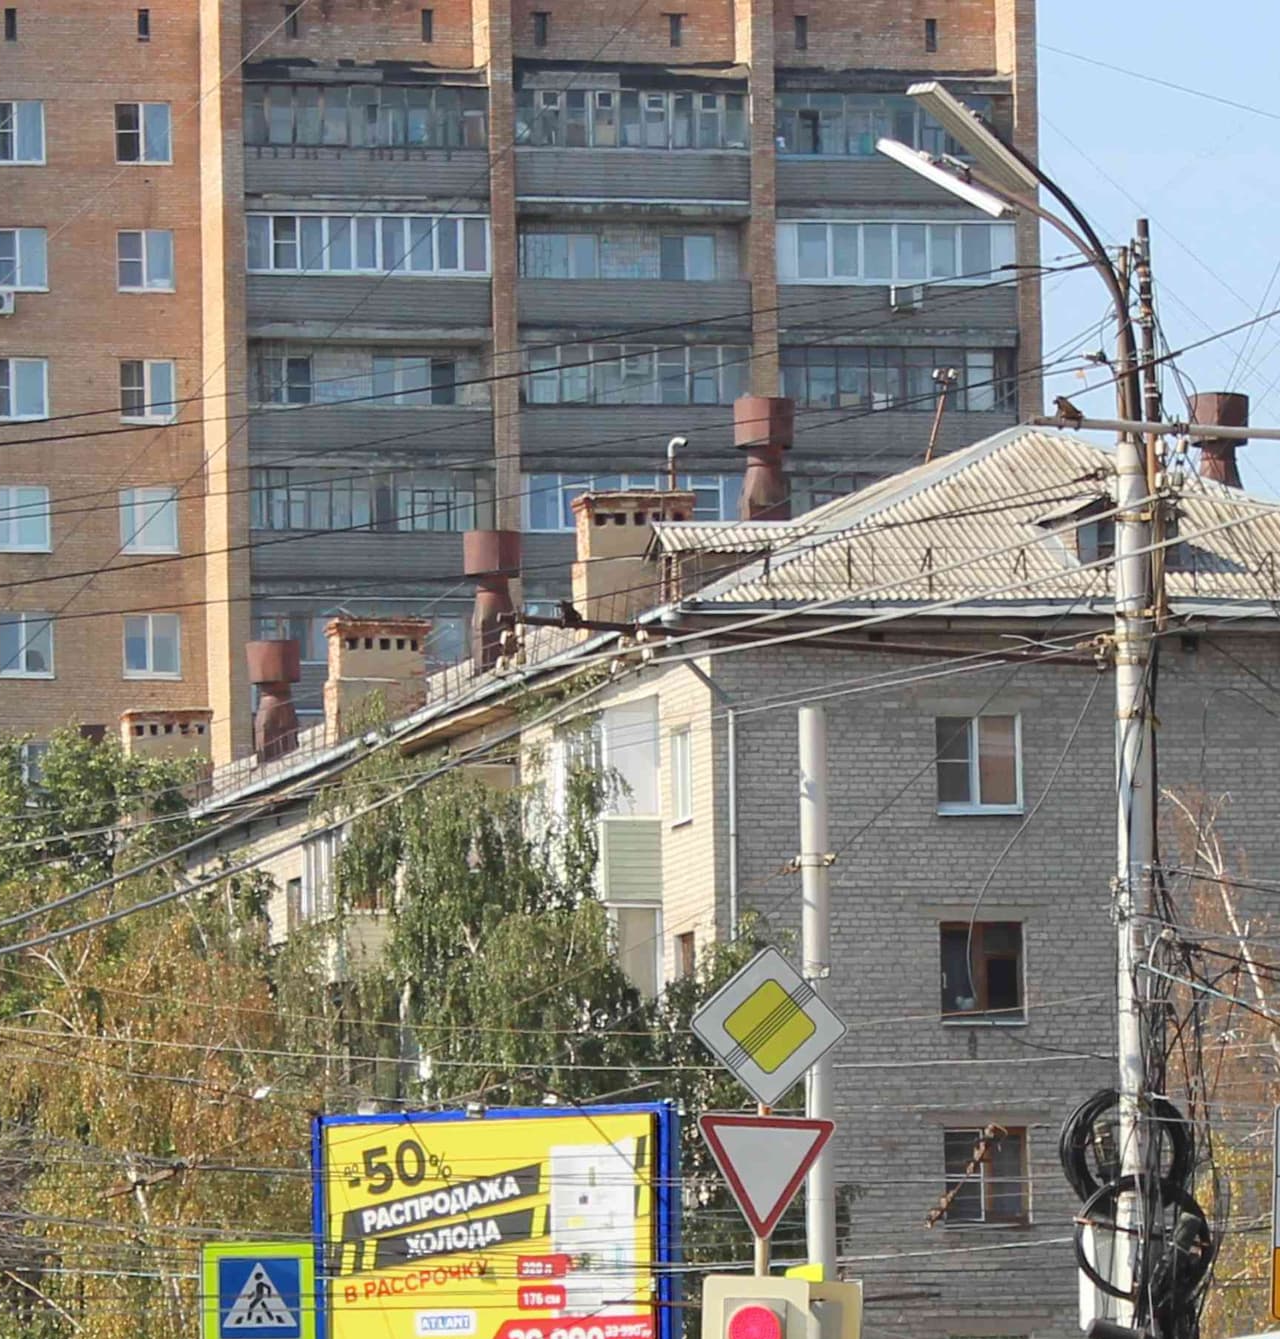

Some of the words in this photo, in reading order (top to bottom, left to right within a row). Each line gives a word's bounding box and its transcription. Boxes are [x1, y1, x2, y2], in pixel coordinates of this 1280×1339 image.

[348, 1139, 452, 1194] -50%
[362, 1176, 520, 1233] РАСПРОДАЖА
[406, 1219, 502, 1258] ХОЛОДА
[344, 1285, 358, 1302] В
[365, 1258, 490, 1299] РАССРОЧКУ
[422, 1316, 470, 1330] ATLANT
